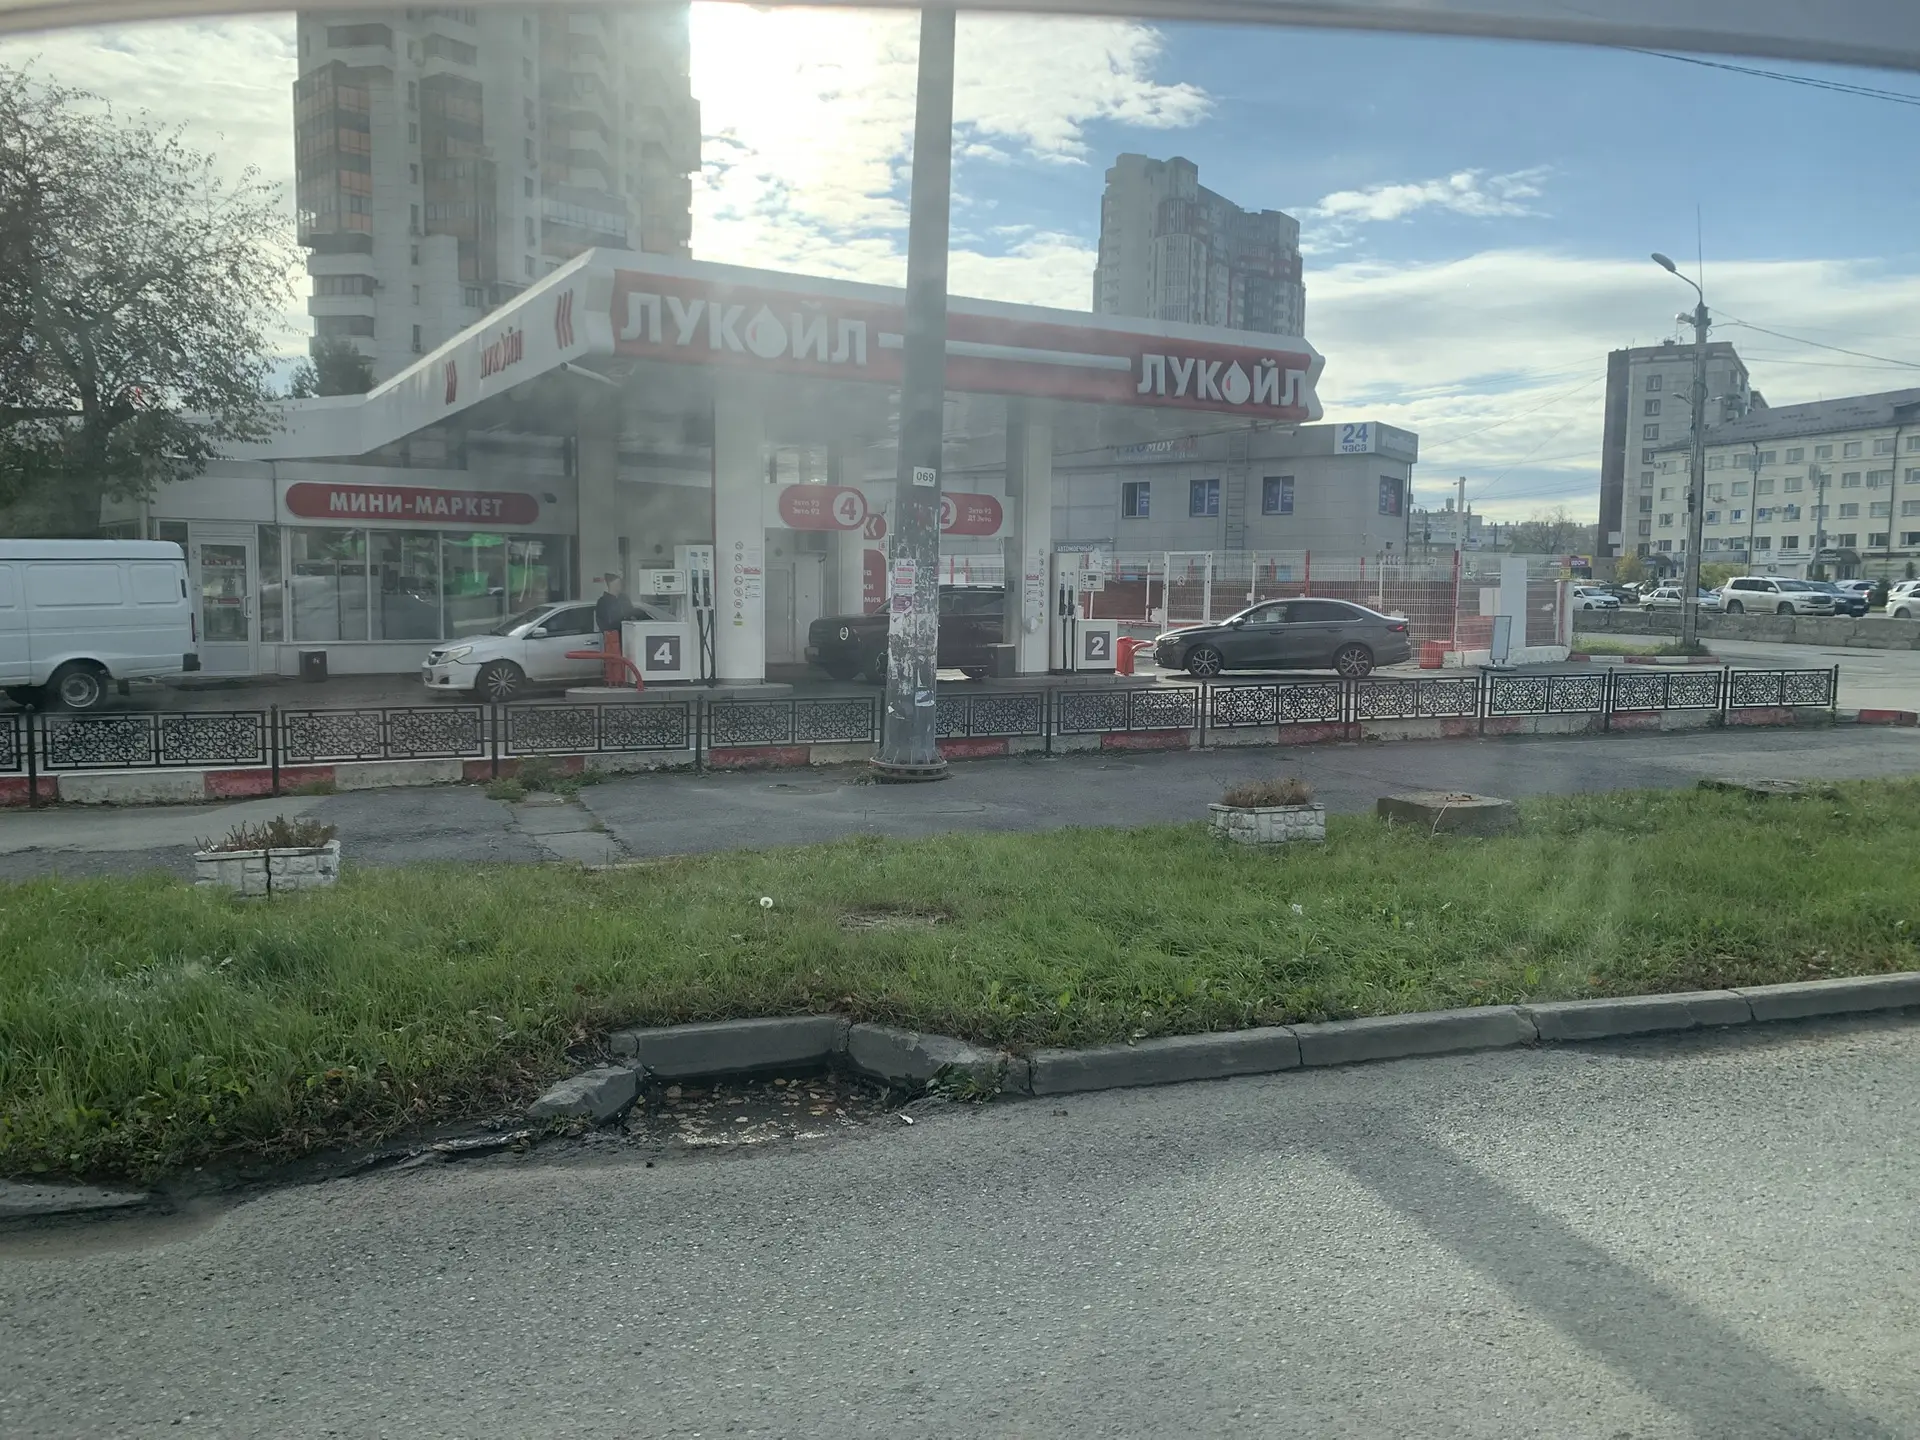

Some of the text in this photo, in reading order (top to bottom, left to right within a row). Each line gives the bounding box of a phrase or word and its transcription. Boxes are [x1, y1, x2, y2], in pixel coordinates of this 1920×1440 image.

[620, 291, 868, 366] ЛУКОЙЛ
[1136, 353, 1308, 408] ЛУКОЙЛ
[1342, 423, 1369, 444] 24
[1342, 443, 1367, 453] часа
[916, 471, 935, 482] 069
[329, 491, 504, 517] МИНИ-МАРКЕТ
[839, 497, 857, 521] 4
[940, 501, 951, 525] 2
[653, 642, 672, 664] 4
[1090, 636, 1105, 656] 2
